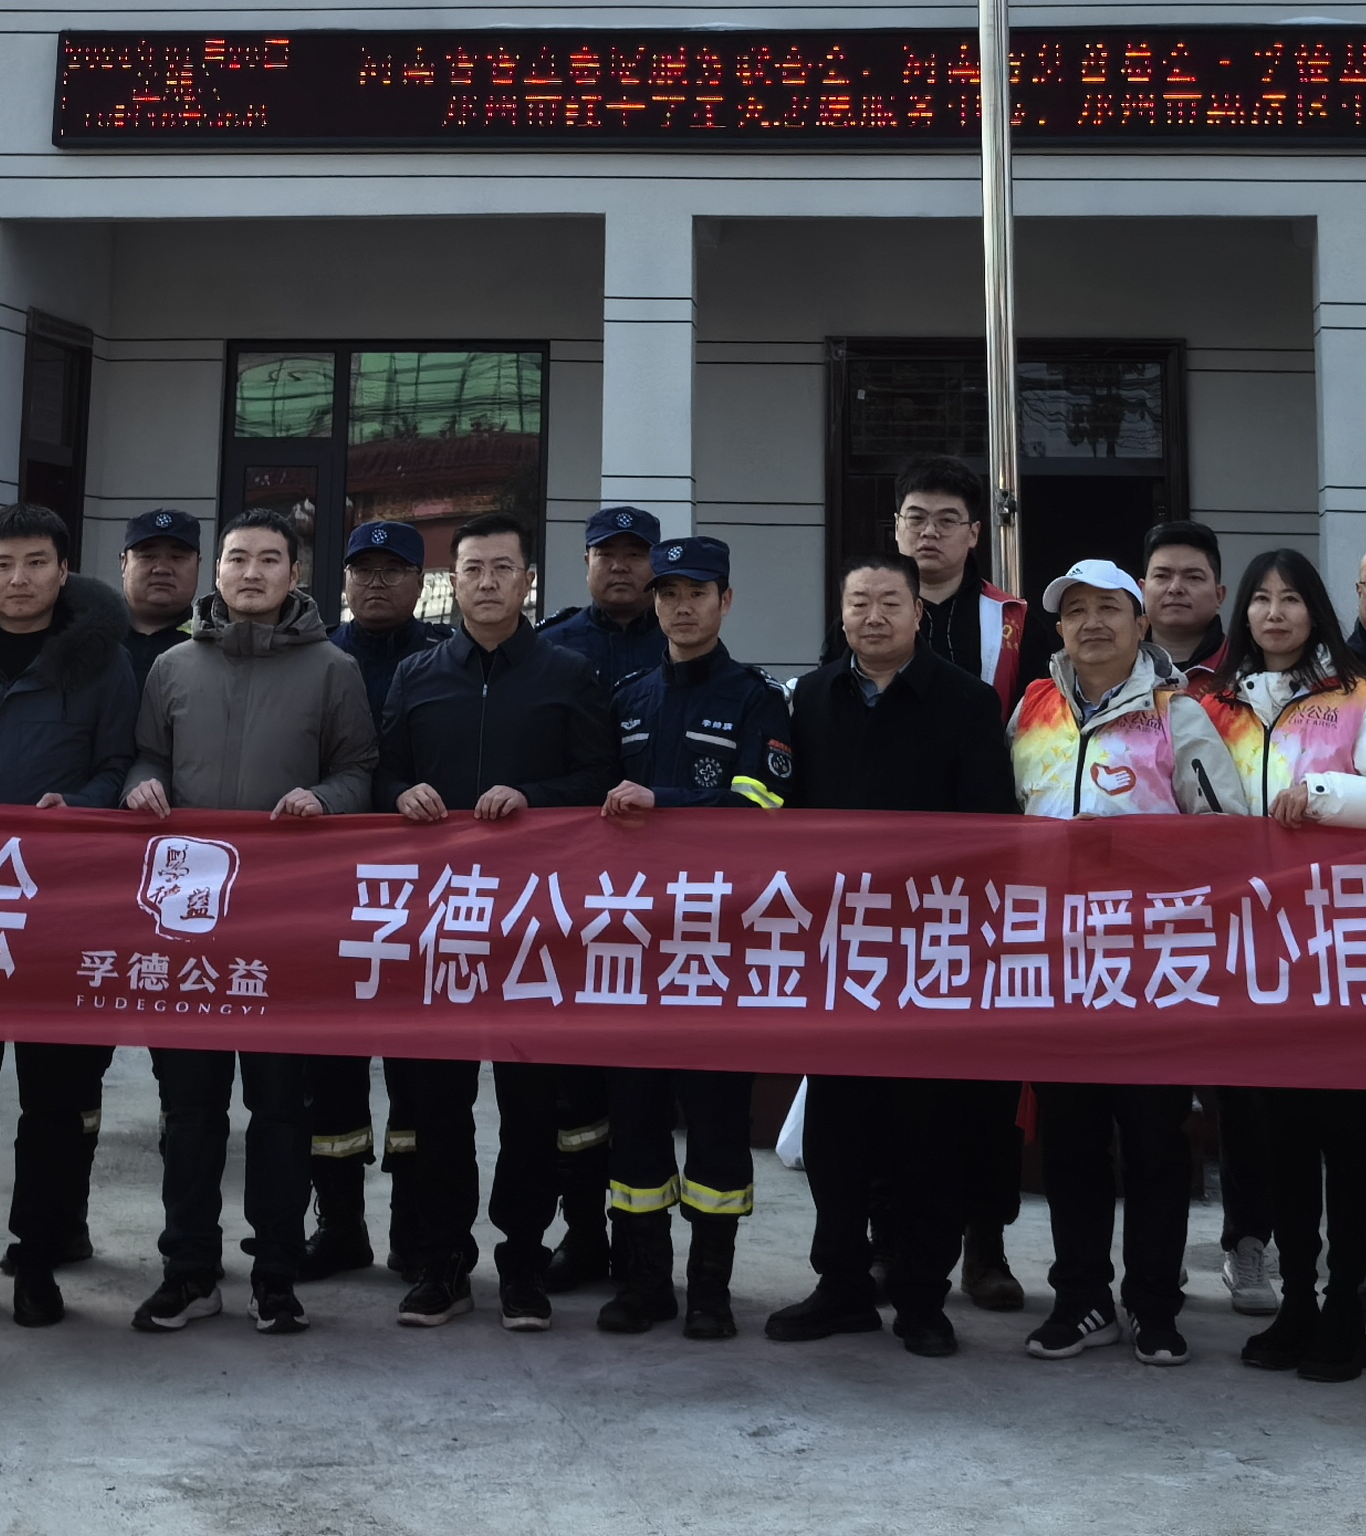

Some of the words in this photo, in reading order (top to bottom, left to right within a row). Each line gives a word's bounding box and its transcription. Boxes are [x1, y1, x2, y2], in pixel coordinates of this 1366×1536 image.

[76, 950, 269, 997] 孚德公益
[76, 995, 265, 1015] FUDEGONGYI
